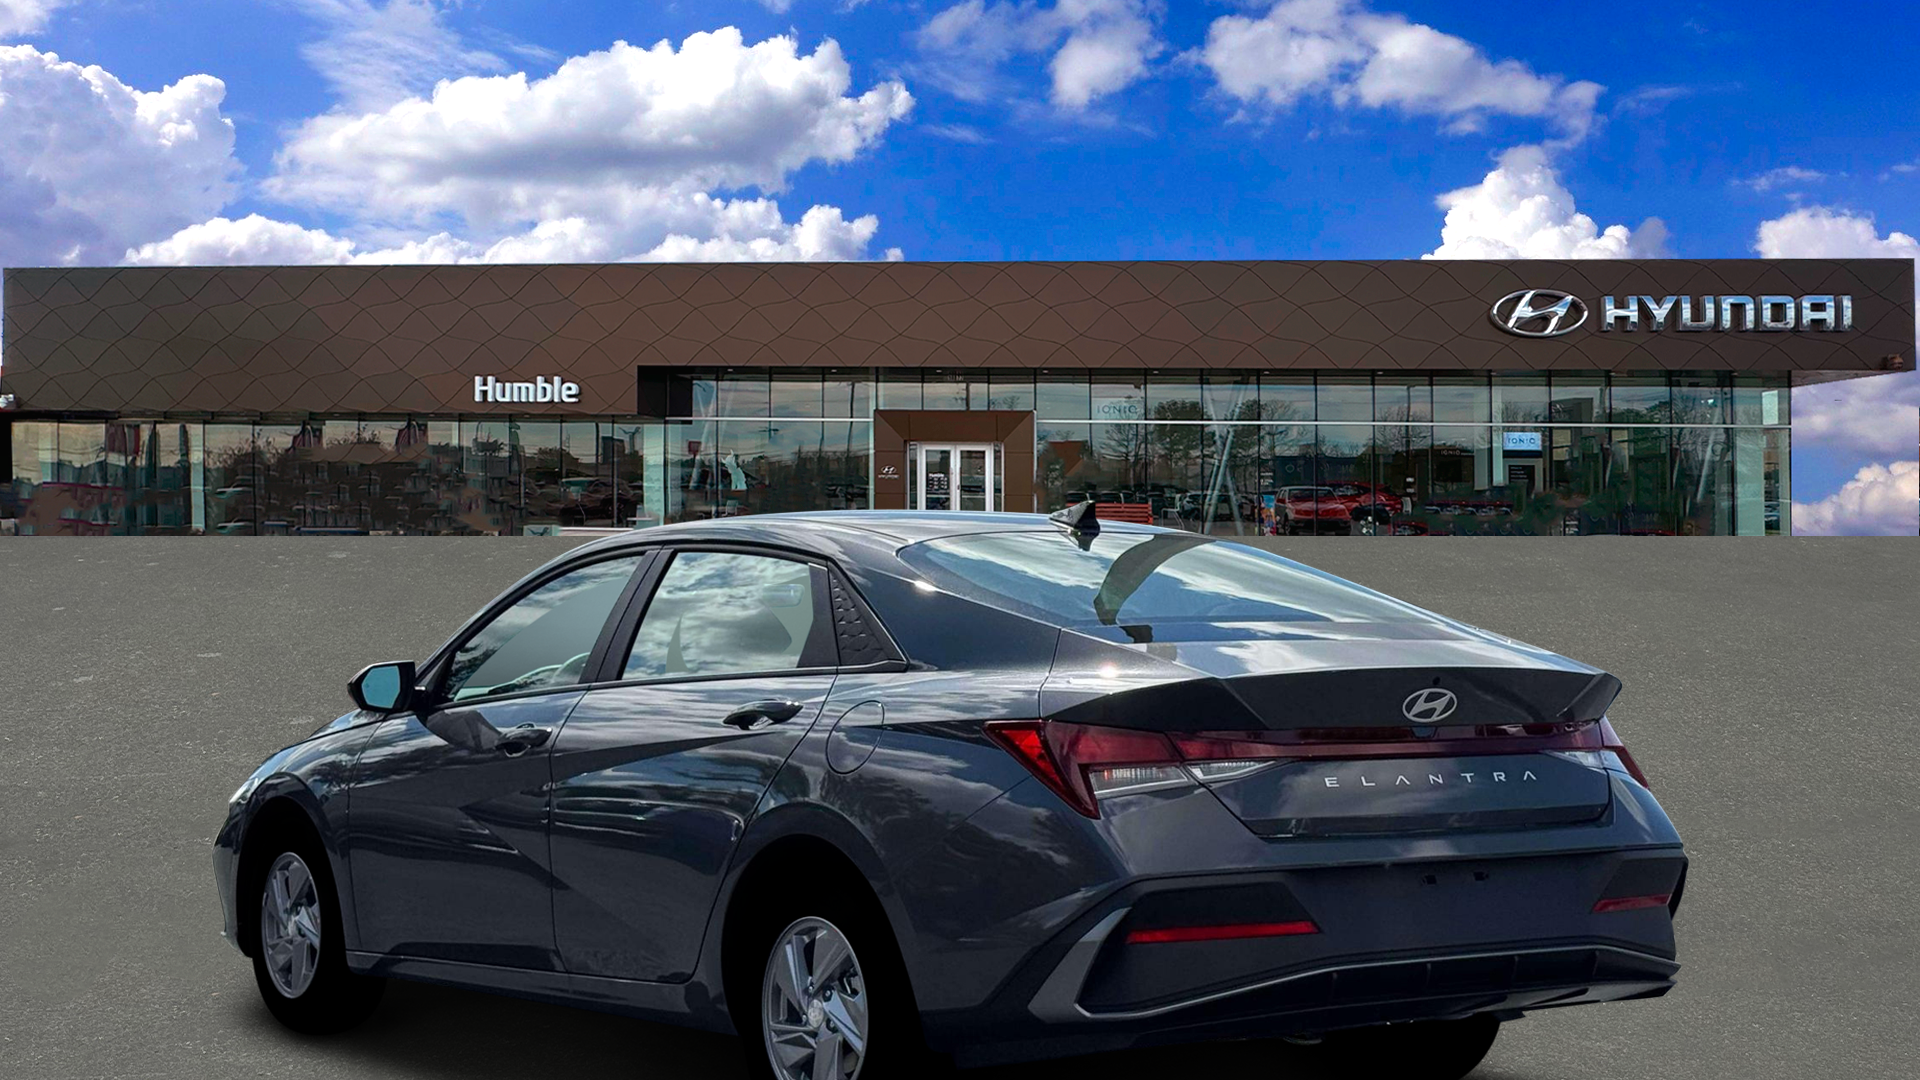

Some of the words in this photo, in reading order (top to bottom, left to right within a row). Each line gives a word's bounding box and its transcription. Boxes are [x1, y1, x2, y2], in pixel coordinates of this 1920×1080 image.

[1602, 295, 1852, 332] HYUNDAI
[474, 375, 580, 402] Humble
[1324, 770, 1537, 787] ELANTRA
